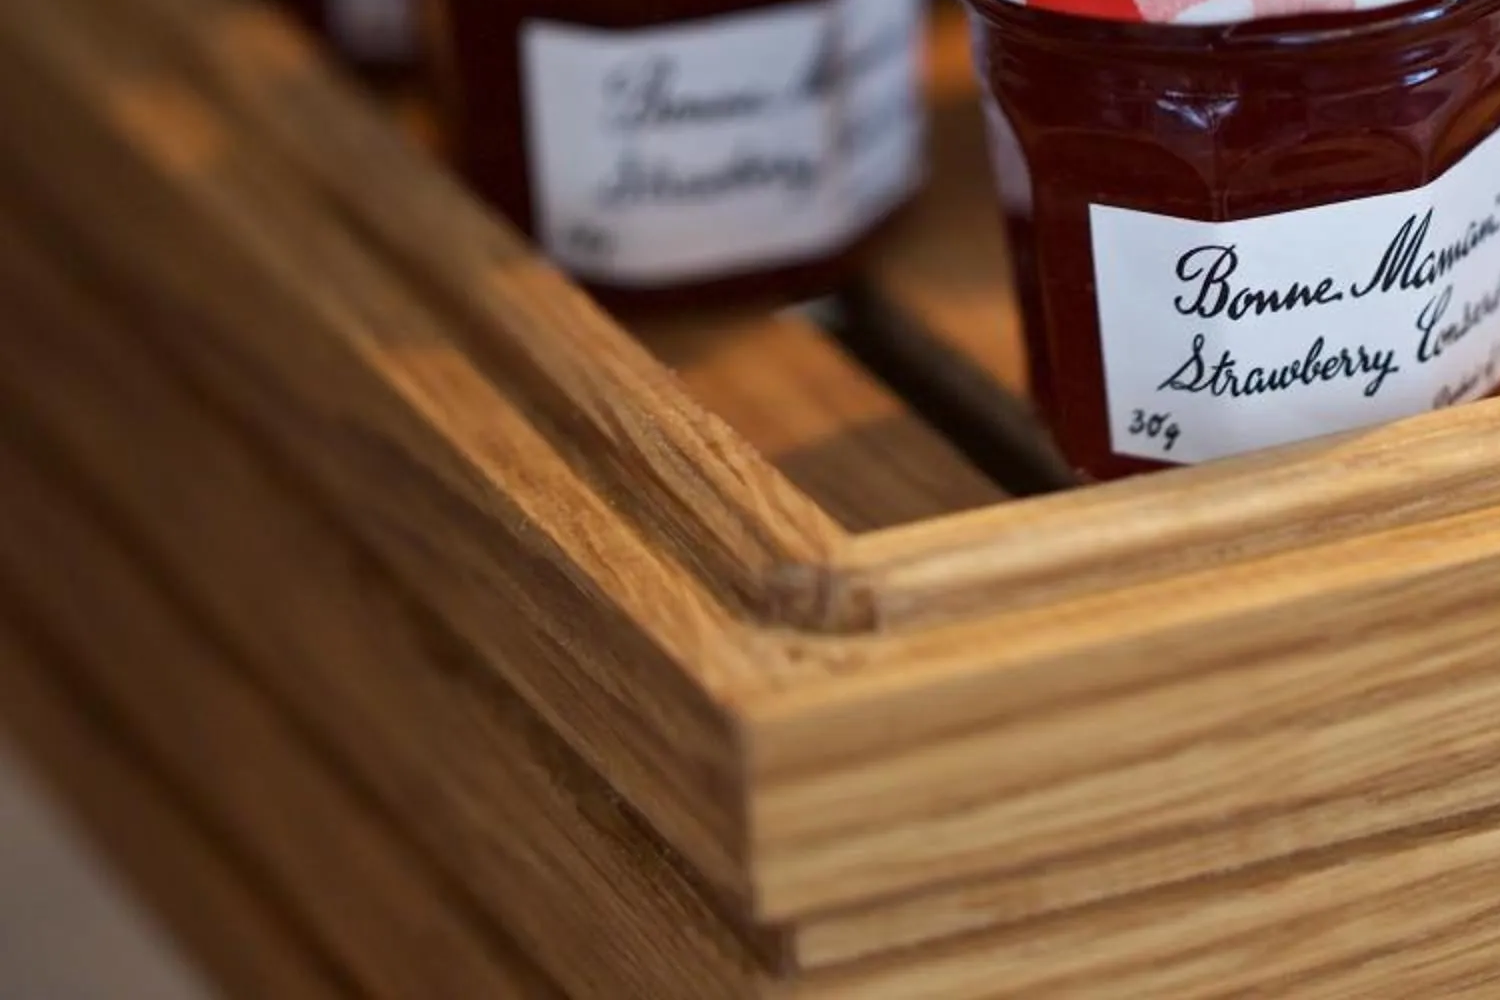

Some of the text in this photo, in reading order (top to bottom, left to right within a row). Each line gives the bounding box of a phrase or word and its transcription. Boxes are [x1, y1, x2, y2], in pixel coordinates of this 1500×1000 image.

[1173, 244, 1344, 321] Bonne
[1157, 334, 1399, 397] Strawberry
[1127, 408, 1181, 451] 30g
